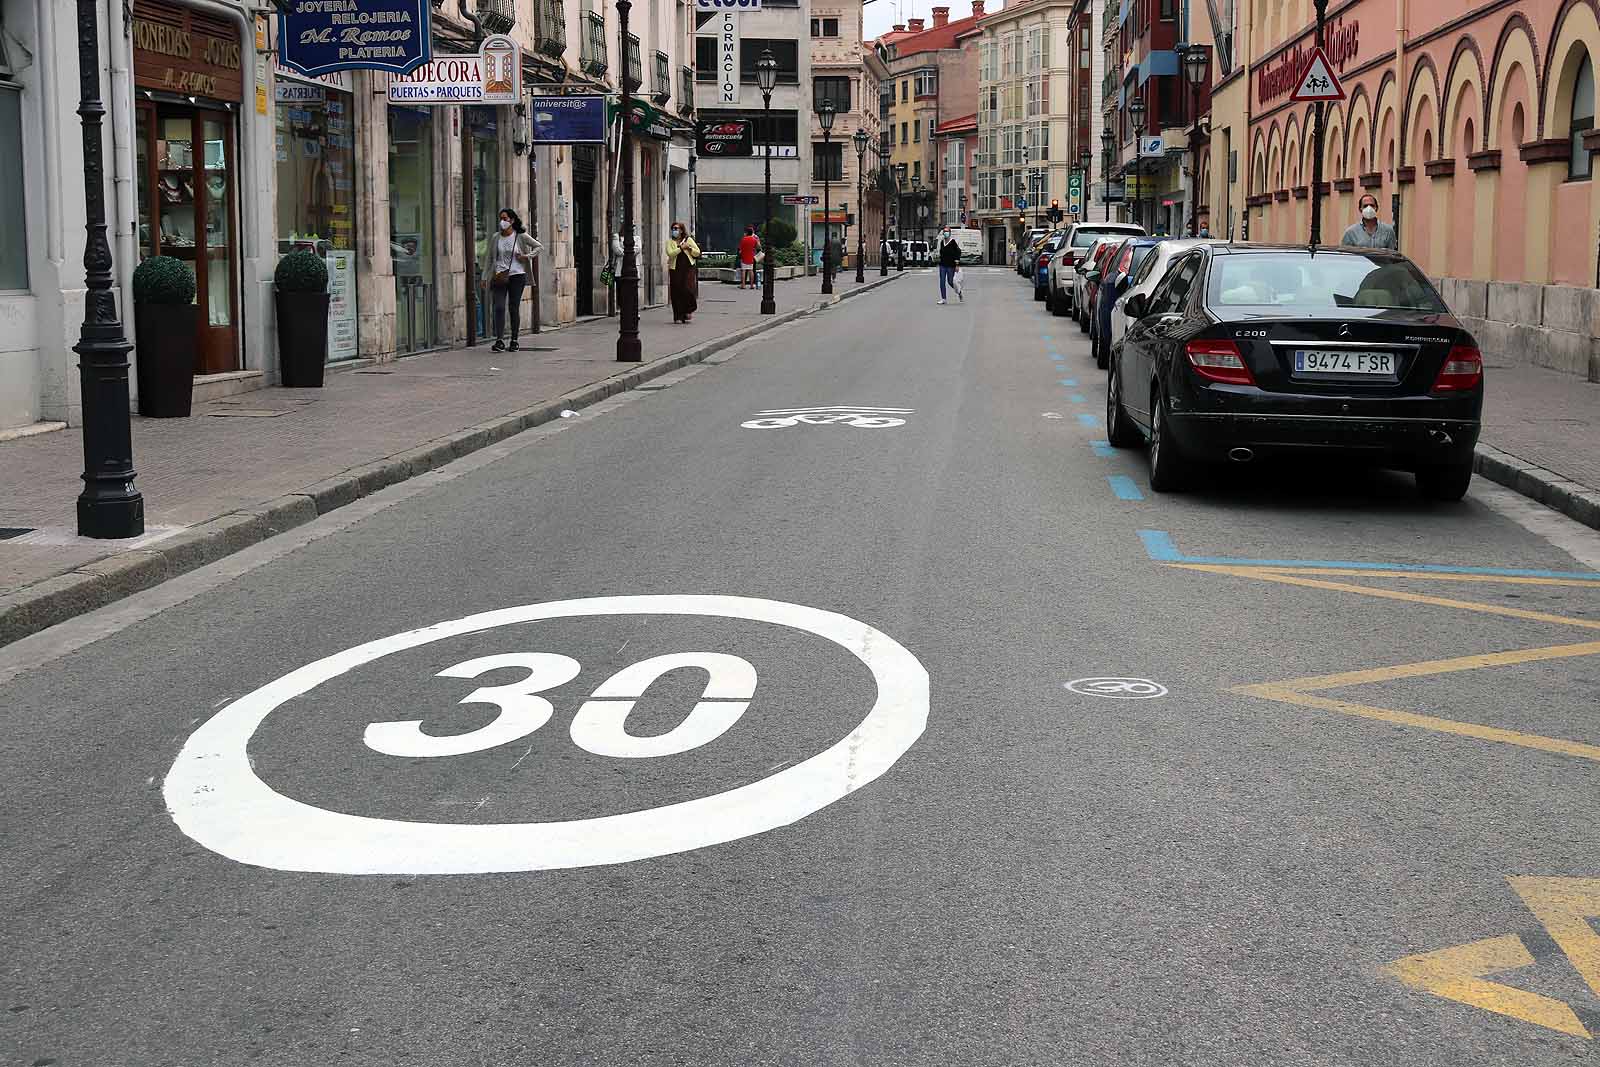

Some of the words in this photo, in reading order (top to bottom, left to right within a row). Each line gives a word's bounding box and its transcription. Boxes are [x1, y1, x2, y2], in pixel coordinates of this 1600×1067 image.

[296, 1, 358, 13] JOYERIA
[331, 10, 412, 25] RELOJERIA
[340, 27, 412, 46] Ramos
[204, 36, 241, 70] JOYAS
[338, 46, 406, 59] PLATERIA
[723, 13, 734, 102] FORMACIÓN
[391, 86, 429, 98] PUERTAS
[436, 86, 482, 101] PARQUETS
[534, 99, 587, 110] universit@s
[1307, 353, 1351, 369] 9474
[1358, 354, 1390, 371] FSR
[363, 651, 758, 758] 30
